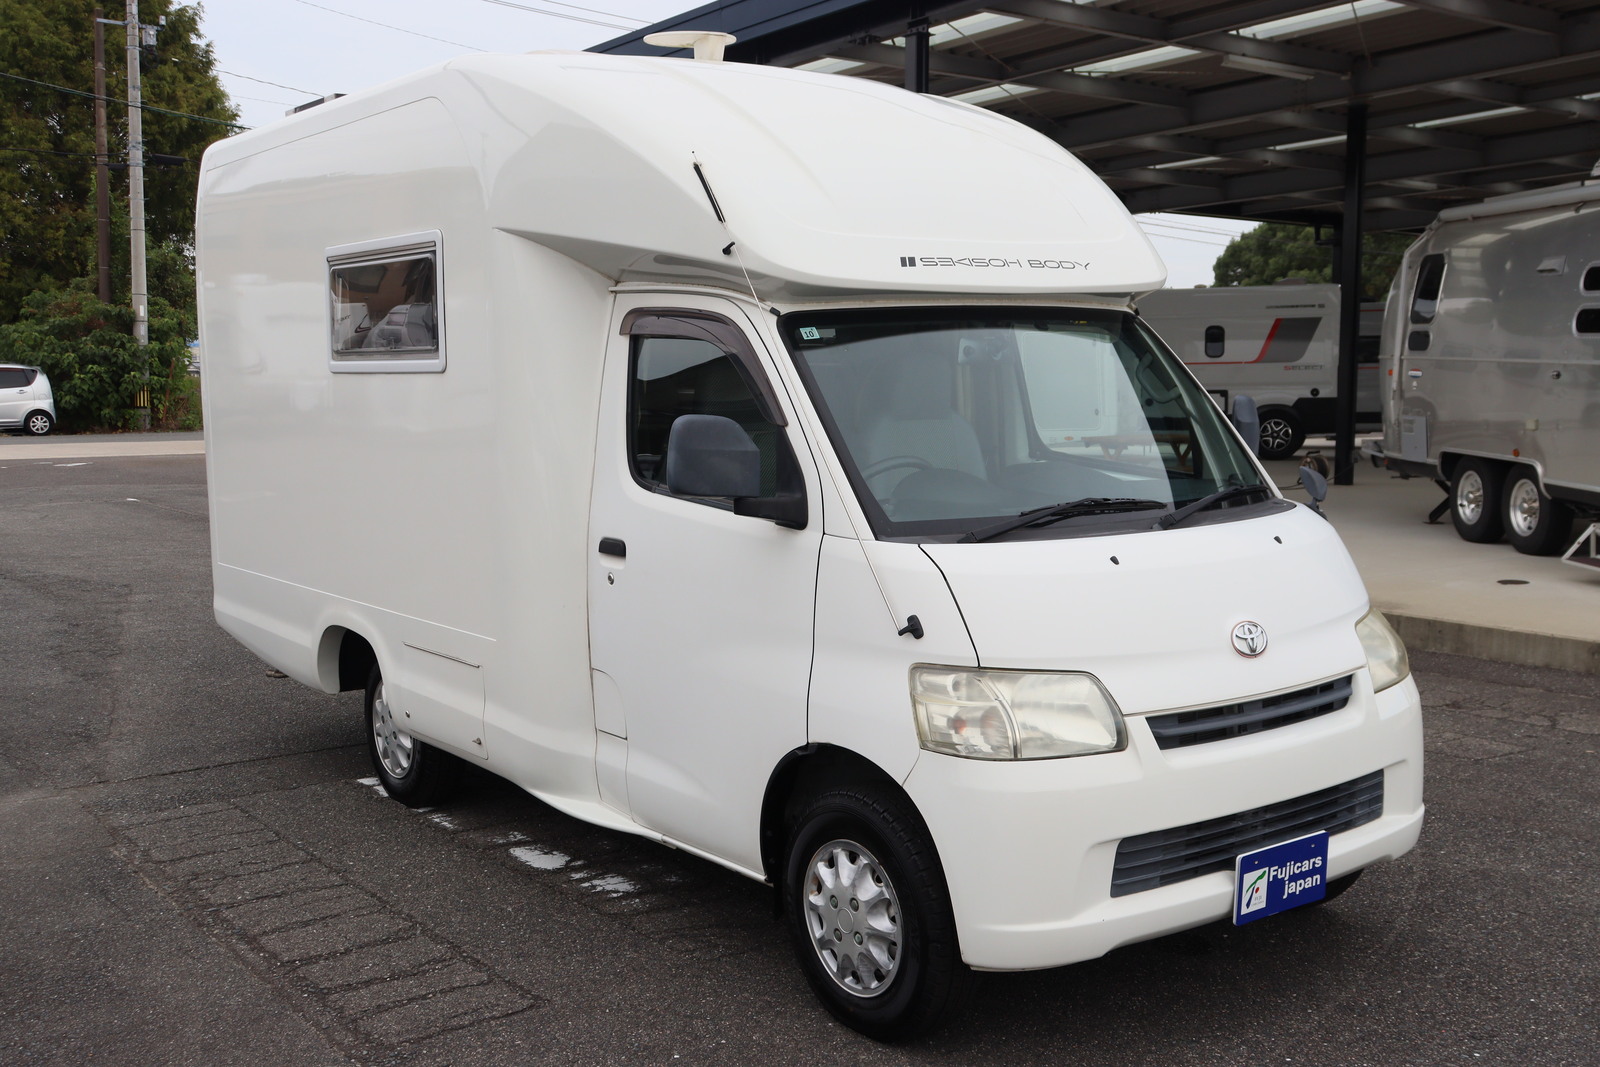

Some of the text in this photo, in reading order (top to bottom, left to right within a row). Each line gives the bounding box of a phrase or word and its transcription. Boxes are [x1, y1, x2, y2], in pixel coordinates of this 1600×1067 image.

[919, 256, 1091, 271] SEKISOH BODY
[1269, 856, 1323, 882] Fujicars
[1282, 874, 1321, 899] japan
